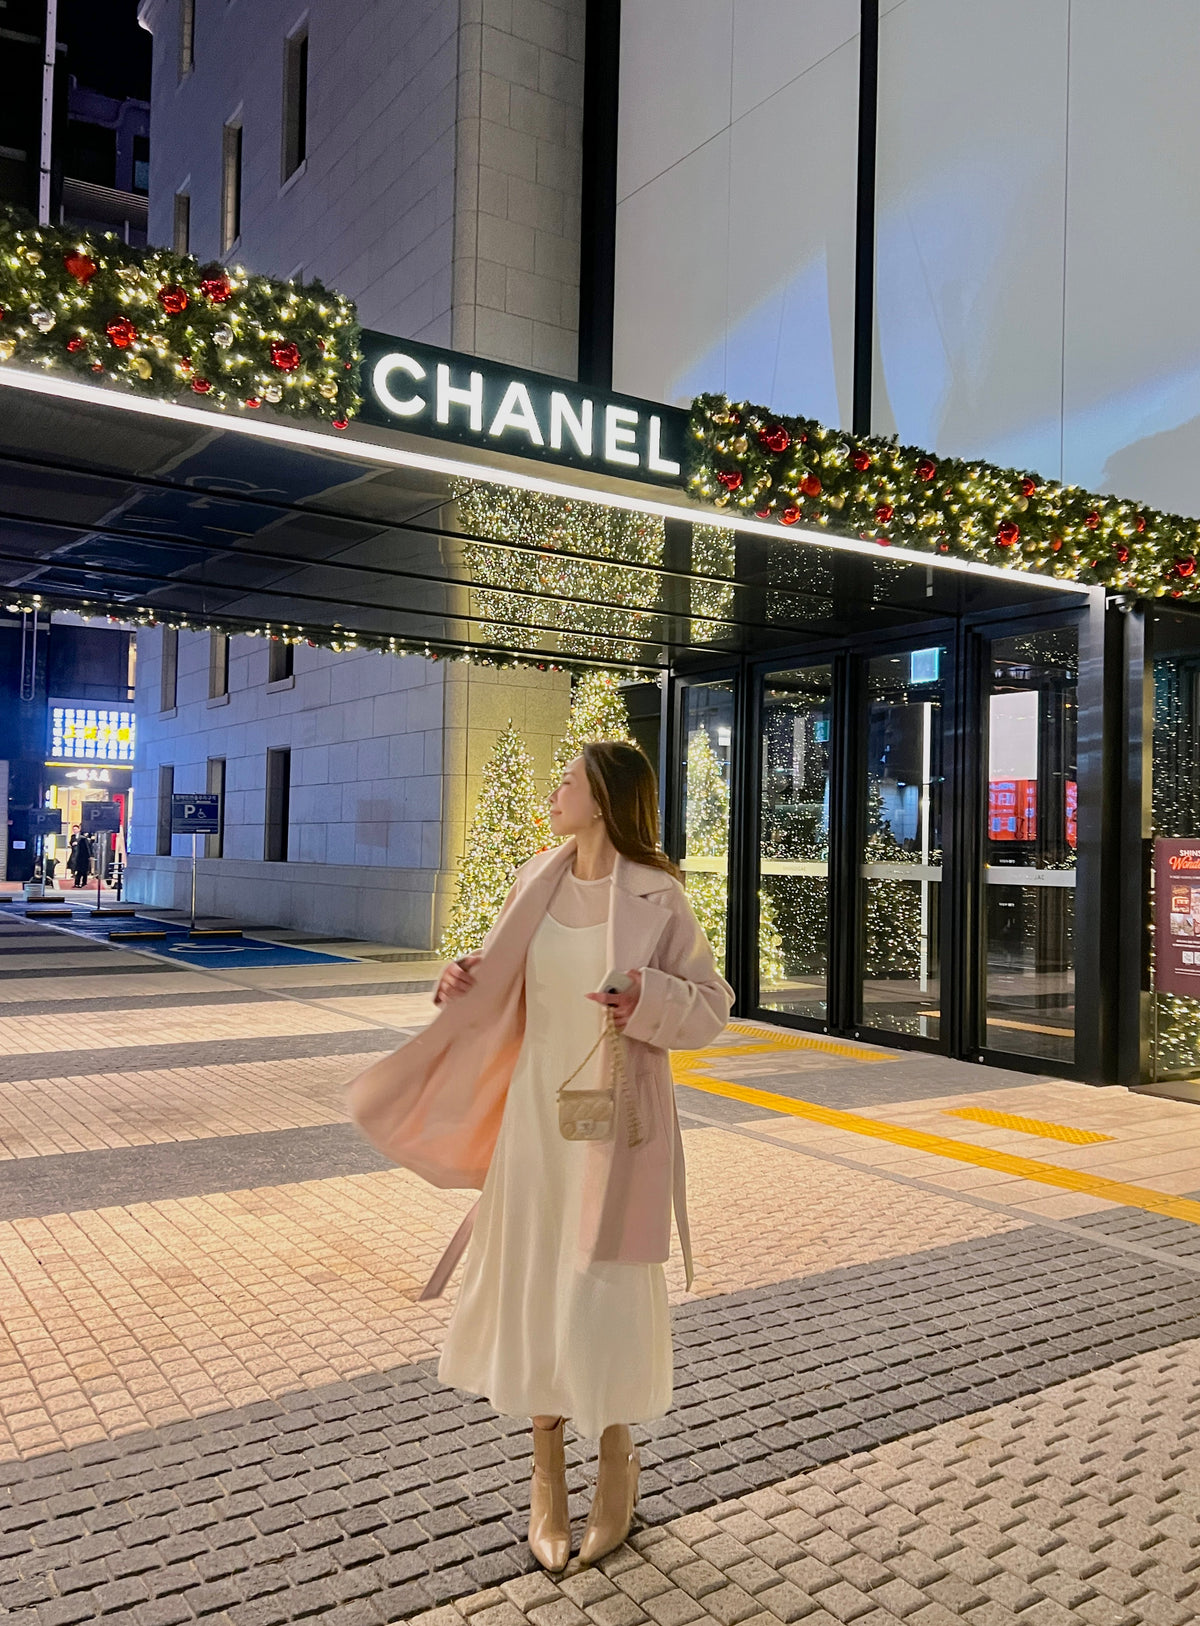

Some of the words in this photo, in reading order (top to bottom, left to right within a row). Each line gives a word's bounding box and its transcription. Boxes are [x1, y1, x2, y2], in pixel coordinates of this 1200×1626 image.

[373, 353, 681, 475] CHANEL
[91, 810, 100, 820] P
[184, 804, 196, 819] P
[37, 815, 46, 824] P
